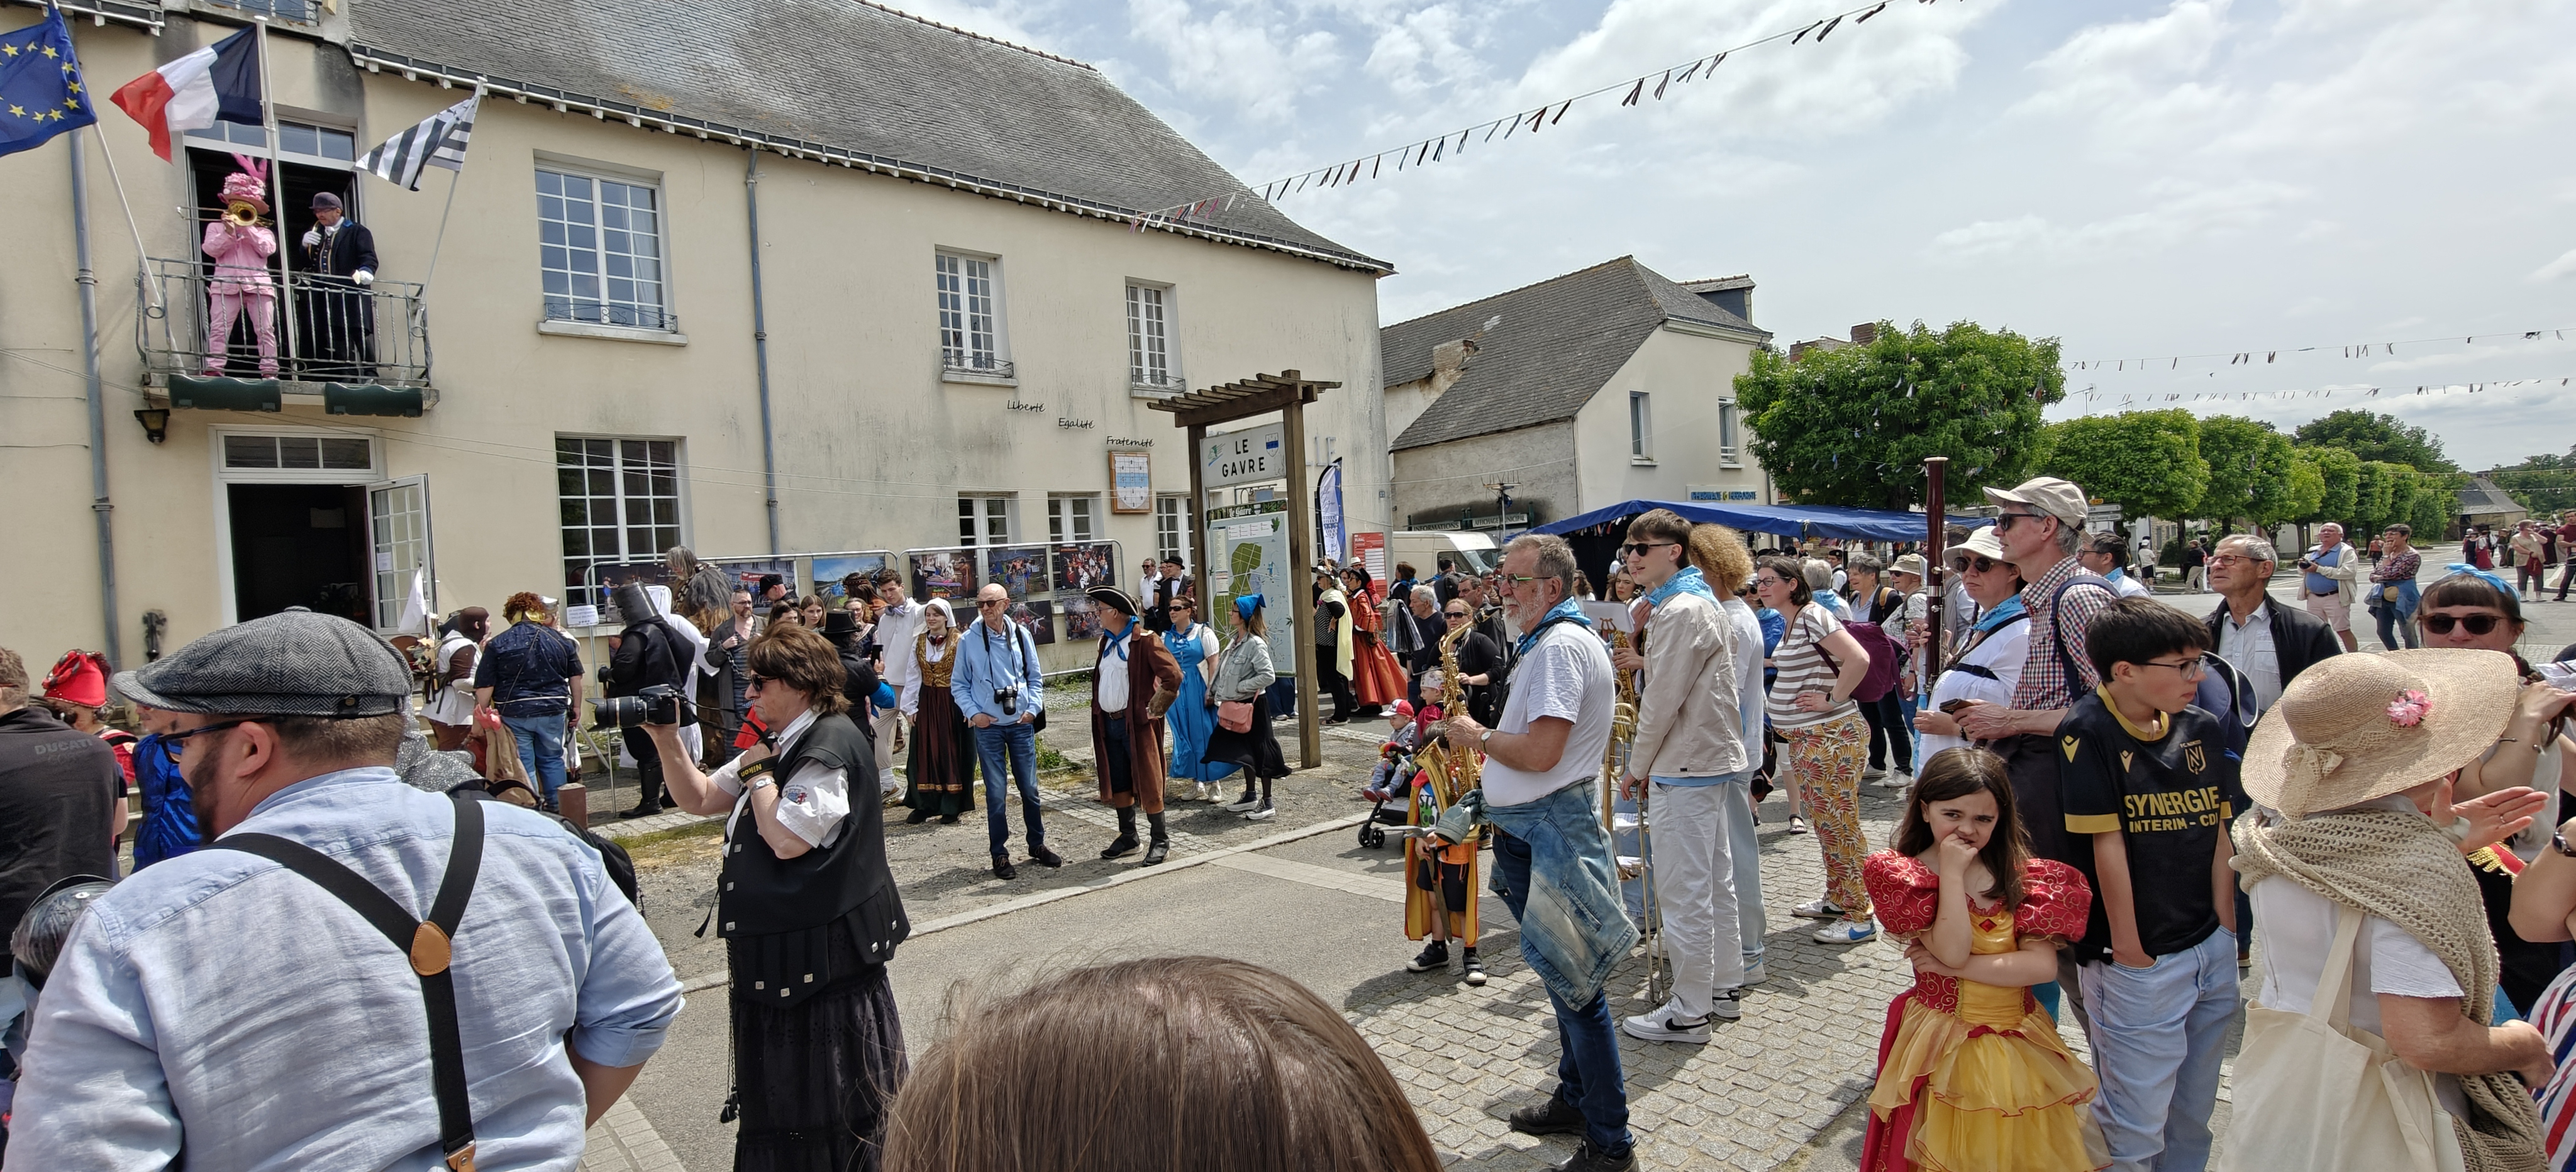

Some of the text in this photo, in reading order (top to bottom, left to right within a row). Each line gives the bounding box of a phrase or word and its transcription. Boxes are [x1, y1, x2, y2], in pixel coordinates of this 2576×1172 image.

[1235, 439, 1249, 455] LE
[1222, 456, 1265, 477] GAVRE
[1413, 522, 1459, 531] INFORMATIONS
[35, 739, 93, 755] DUCATI
[740, 763, 763, 777] Nikon
[2124, 786, 2220, 818] SYNERGIE
[2129, 817, 2189, 833] INTERIM
